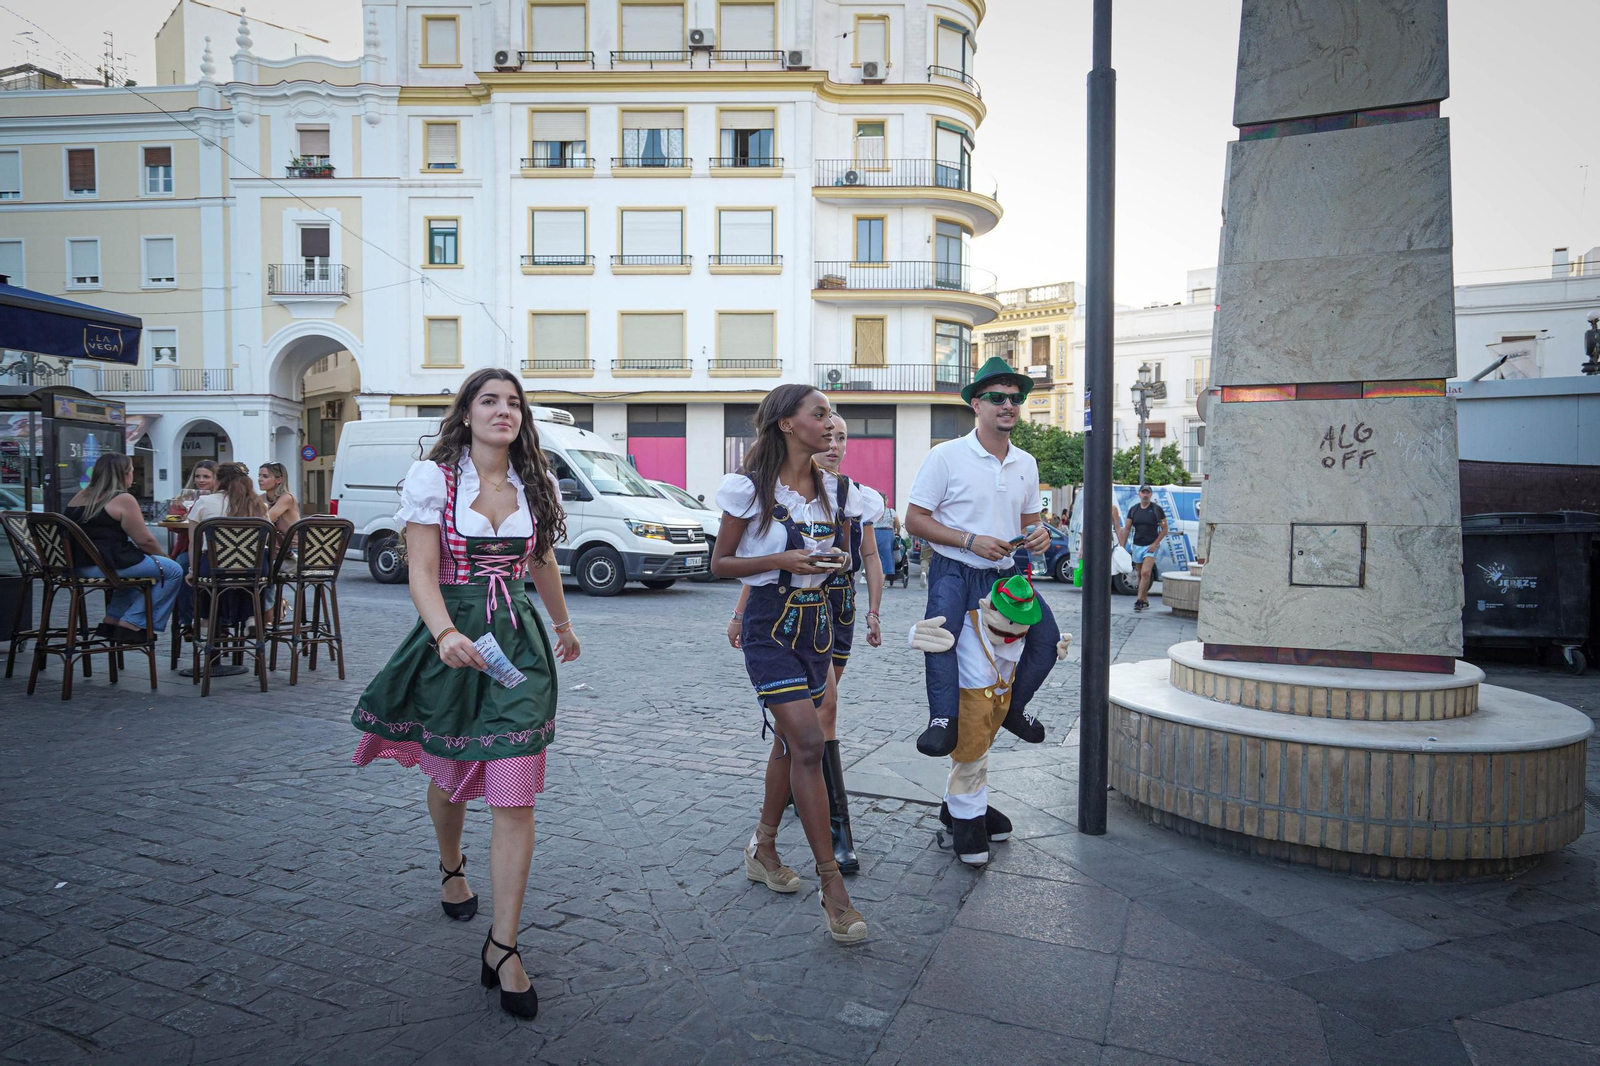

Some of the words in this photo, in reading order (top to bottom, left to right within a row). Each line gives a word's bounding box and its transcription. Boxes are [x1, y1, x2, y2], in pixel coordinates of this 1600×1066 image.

[96, 334, 110, 343] LA
[88, 342, 119, 352] VEGA
[1445, 386, 1462, 394] lat
[1319, 421, 1374, 451] ALG
[1321, 449, 1377, 470] OFF
[1159, 491, 1175, 526] VENTA
[1498, 579, 1530, 587] JEREZ
